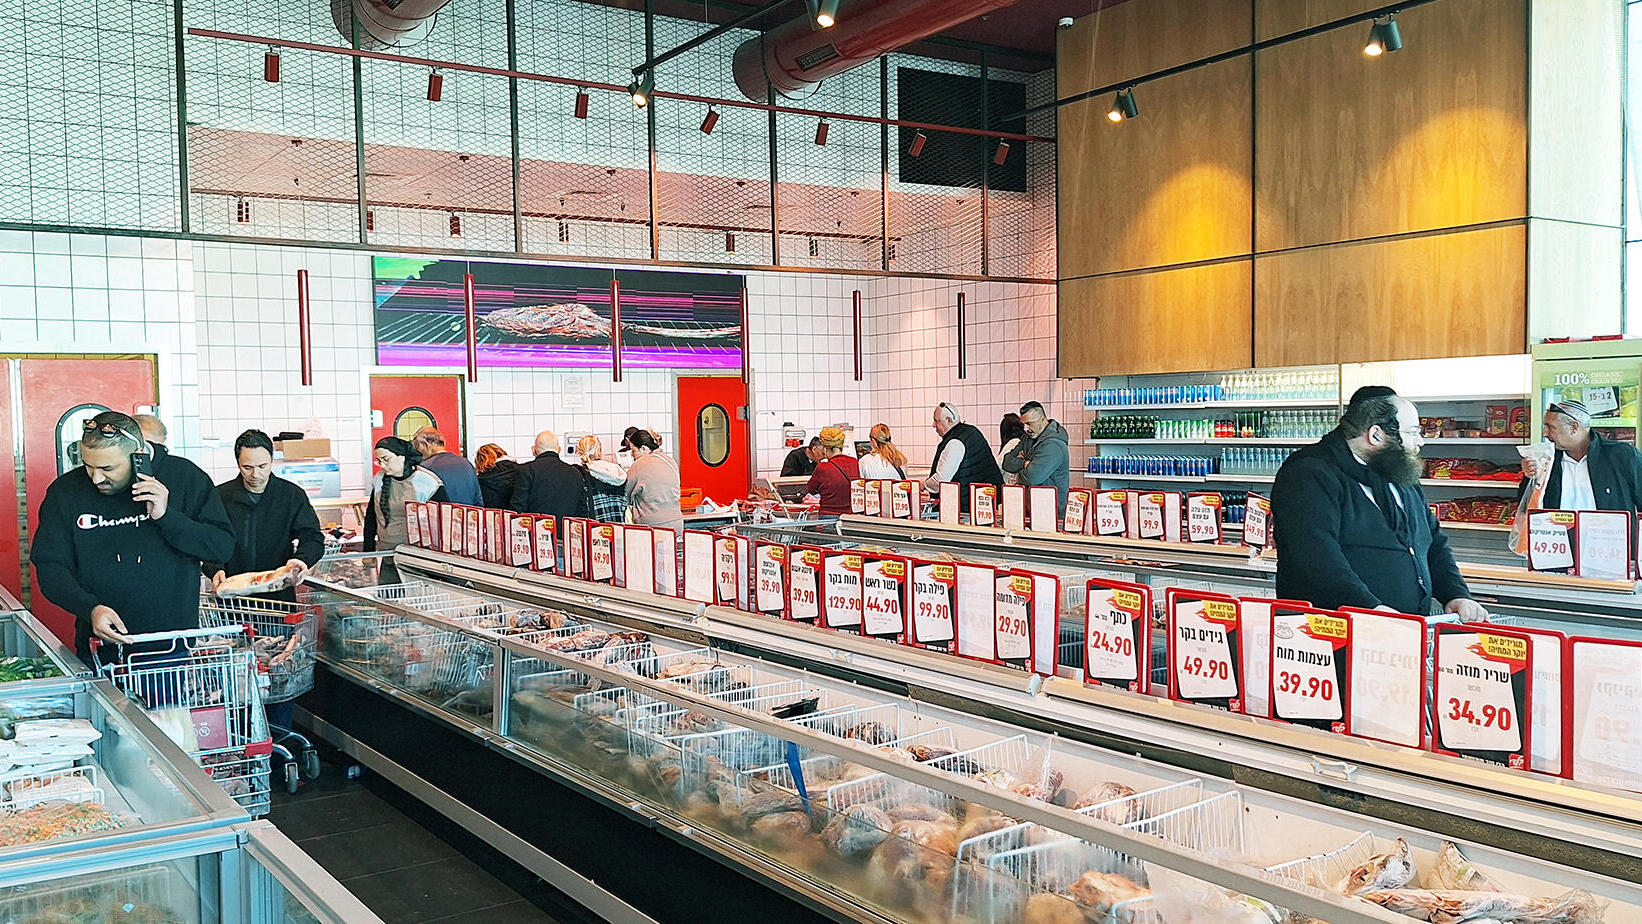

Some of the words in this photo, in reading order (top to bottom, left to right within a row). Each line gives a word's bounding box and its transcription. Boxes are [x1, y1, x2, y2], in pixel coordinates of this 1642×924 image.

[1554, 373, 1590, 386] 100%
[1102, 519, 1119, 527] 59.9
[1192, 525, 1214, 534] 59.90
[1534, 542, 1566, 554] 49.90
[762, 579, 780, 593] 39.90
[828, 573, 842, 585] בקר
[844, 574, 857, 585] מוח
[883, 580, 896, 590] בשר
[914, 582, 927, 594] בקר
[929, 582, 945, 595] פילה
[793, 588, 814, 604] 39.90
[1014, 595, 1025, 606] פילה
[829, 596, 860, 611] 129.90
[867, 596, 897, 614] 44.90
[920, 602, 948, 619] 99.90
[1110, 610, 1126, 625] כתף
[999, 615, 1026, 637] 29.90
[1179, 626, 1196, 641] בקר
[1200, 630, 1223, 644] גידים
[1093, 631, 1131, 656] 24.90
[1500, 639, 1522, 648] מורידים
[1276, 646, 1294, 661] מוח
[1297, 650, 1330, 666] עצמות
[1513, 650, 1526, 658] יוקר
[1184, 656, 1228, 680] 49.90
[1456, 664, 1480, 678] מוזה
[1483, 668, 1509, 683] שריר
[1280, 671, 1333, 701] 39.90
[1448, 698, 1511, 731] 34.90
